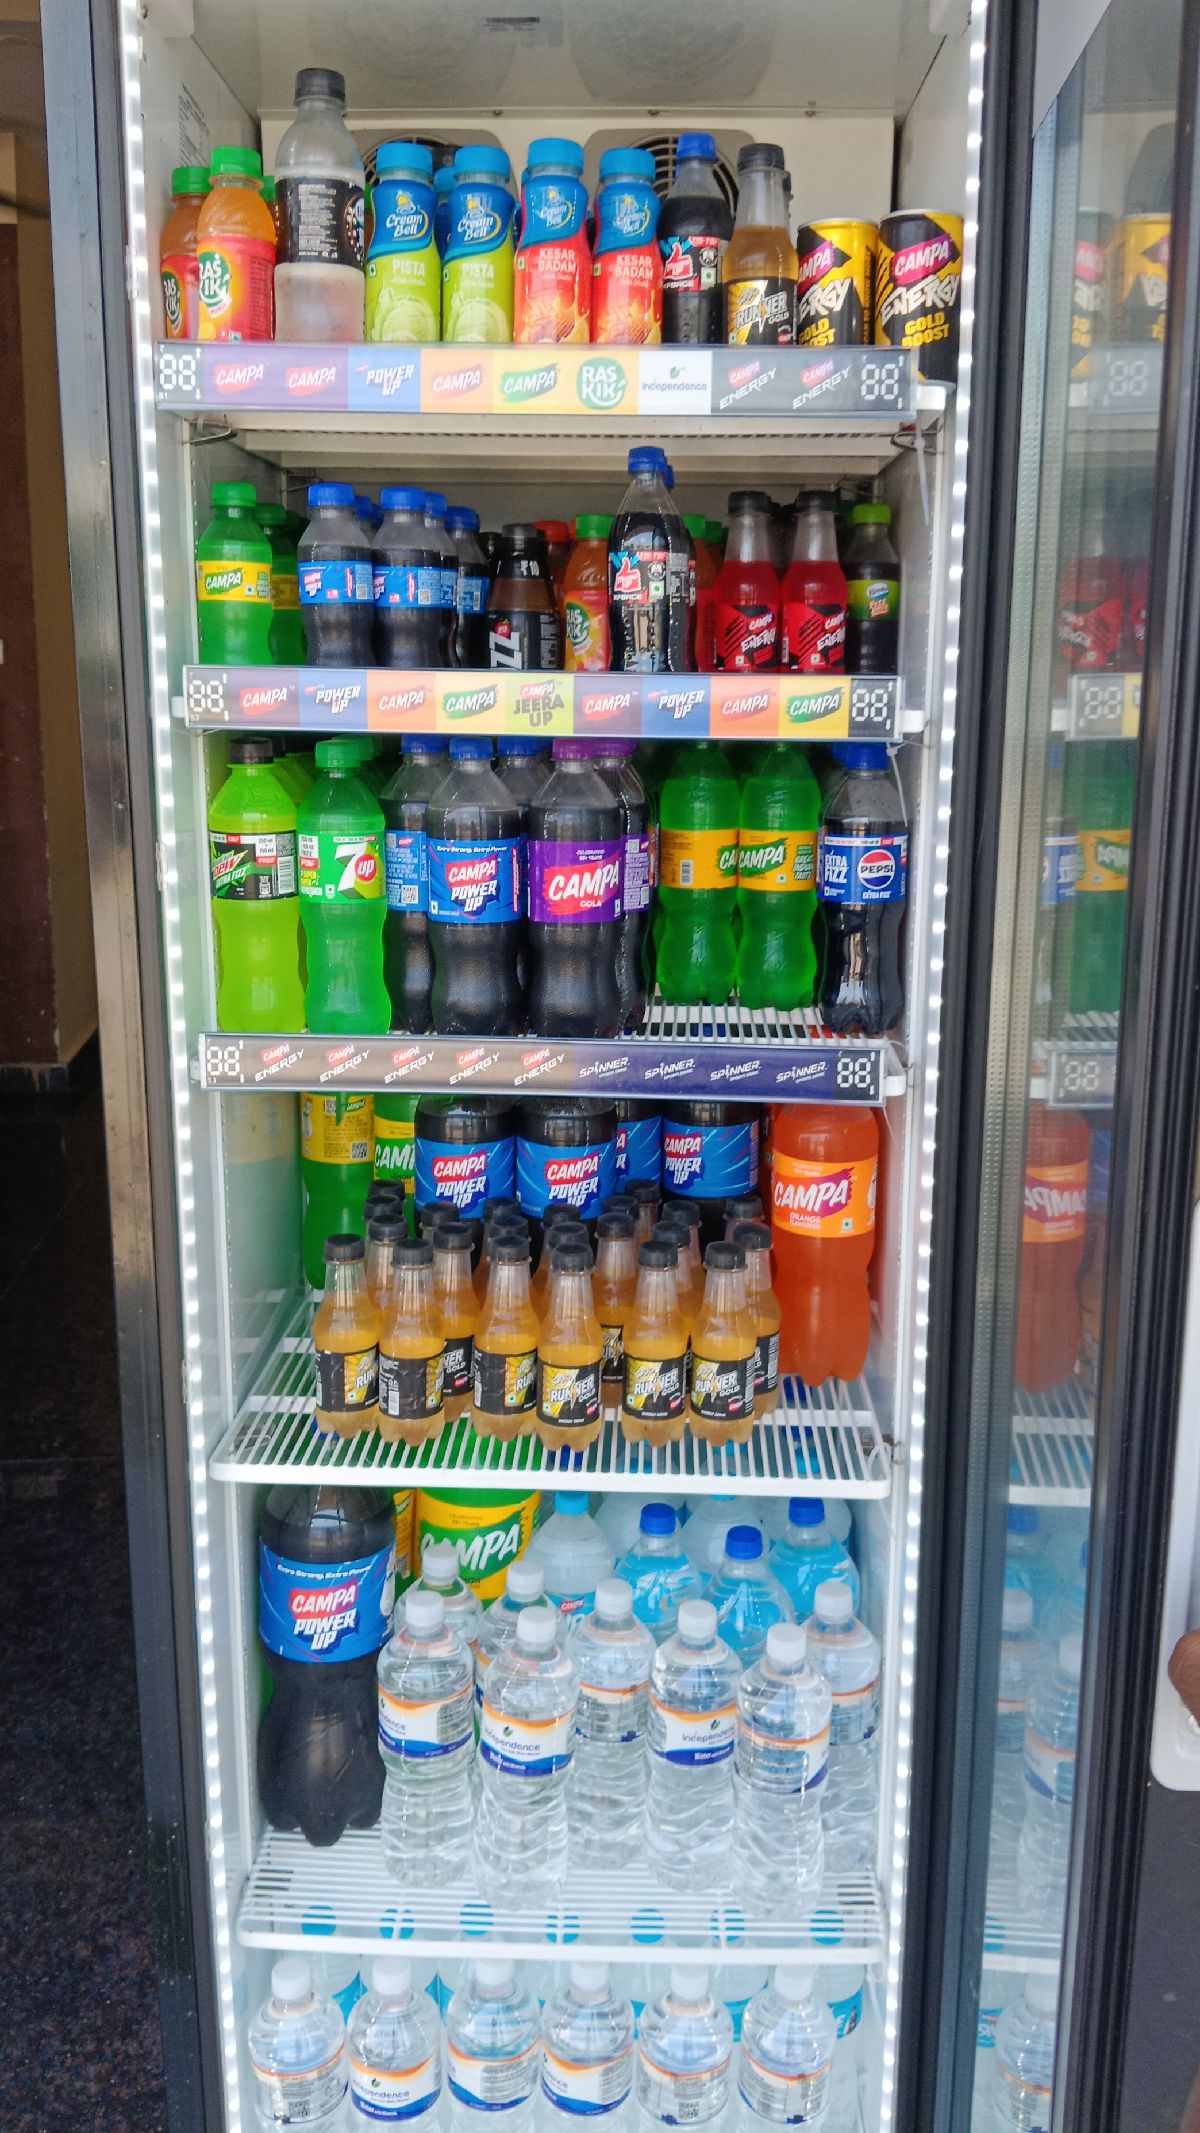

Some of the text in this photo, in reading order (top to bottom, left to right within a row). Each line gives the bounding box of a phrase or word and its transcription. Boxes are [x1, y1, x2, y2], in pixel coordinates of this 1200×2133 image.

[386, 213, 423, 231] Cream
[395, 223, 418, 237] Bell
[457, 216, 494, 237] Cream
[464, 226, 487, 241] Bell
[540, 248, 575, 261] KESAR
[616, 255, 652, 268] KESAR
[799, 248, 834, 282] AMPA
[894, 241, 950, 277] CAMPA
[392, 260, 425, 277] PISTA
[462, 263, 495, 279] PISTA
[538, 260, 577, 273] BADAM
[615, 266, 654, 280] BADAM
[798, 277, 853, 323] ERGY
[880, 275, 960, 328] ENERGY
[757, 311, 790, 326] GOLD
[904, 312, 946, 335] GOLD
[160, 354, 196, 391] 88
[216, 364, 264, 386] CAMPA
[288, 366, 337, 388] CAMPA
[366, 364, 415, 385] POWER
[432, 370, 481, 392] CAMPA
[503, 370, 556, 394] CAMPA
[581, 366, 618, 384] RAS
[729, 360, 760, 383] CAMPA
[802, 360, 834, 383] CAMPA
[861, 364, 900, 400] 88
[382, 380, 401, 396] UP
[581, 383, 618, 401] KIK
[641, 380, 707, 394] Independence
[720, 367, 777, 410] ENERGY
[793, 366, 851, 410] ENERGY
[205, 571, 242, 590] CAMPA
[189, 680, 224, 713] 88
[243, 687, 288, 708] CAMPA
[315, 685, 361, 704] POWER
[521, 683, 554, 697] CAMPA
[657, 690, 705, 710] POWER
[331, 698, 349, 715] UP
[378, 691, 424, 712] CAMPA
[446, 690, 496, 713] CAMPA
[513, 694, 565, 715] JEERA
[585, 693, 631, 713] CAMPA
[673, 703, 692, 720] UP
[721, 694, 769, 716] CAMPA
[789, 693, 840, 717] CAMPA
[852, 688, 889, 723] 88
[529, 710, 553, 727] UP
[334, 842, 370, 898] 7
[825, 854, 848, 866] EXTRA
[861, 865, 894, 874] PEPSI
[231, 866, 248, 880] FIZZ
[448, 859, 497, 883] CAMPA
[548, 860, 620, 901] CAMPA
[825, 865, 848, 884] FIZZ
[451, 880, 498, 901] POWER
[464, 895, 483, 912] UP
[580, 900, 602, 908] COLA
[207, 1046, 241, 1076] 88
[263, 1044, 292, 1061] CAMPA
[328, 1045, 354, 1063] CAMPA
[393, 1046, 420, 1065] CAMPA
[458, 1047, 484, 1066] CAMPA
[523, 1048, 549, 1067] CAMPA
[255, 1048, 304, 1082] ENERGY
[319, 1050, 370, 1084] ENERGY
[384, 1051, 435, 1085] ENERGY
[449, 1052, 499, 1086] ENERGY
[514, 1053, 565, 1087] ENERGY
[579, 1057, 629, 1078] SPINNER
[644, 1058, 694, 1080] SPINNER
[710, 1060, 760, 1081] SPINNER
[776, 1061, 826, 1083] SPINNER
[837, 1057, 871, 1088] 88
[664, 1134, 703, 1154] CAMPA
[375, 1144, 415, 1170] CAM
[433, 1155, 486, 1178] CAMPA
[547, 1153, 599, 1181] CAMPA
[665, 1156, 702, 1170] POWER
[435, 1176, 487, 1197] POWER
[673, 1168, 689, 1184] UP
[548, 1175, 599, 1200] POWER
[774, 1179, 849, 1212] CAMPA
[452, 1191, 472, 1208] UP
[789, 1211, 821, 1223] ORANGE
[446, 1362, 466, 1374] GOLD
[578, 1387, 596, 1403] GOLD
[661, 1383, 680, 1396] GOLD
[719, 1385, 740, 1397] GOLD
[291, 1585, 357, 1613] CAMPA
[560, 1599, 584, 1613] CAMPA
[293, 1608, 357, 1636] POWER
[310, 1632, 338, 1651] UP
